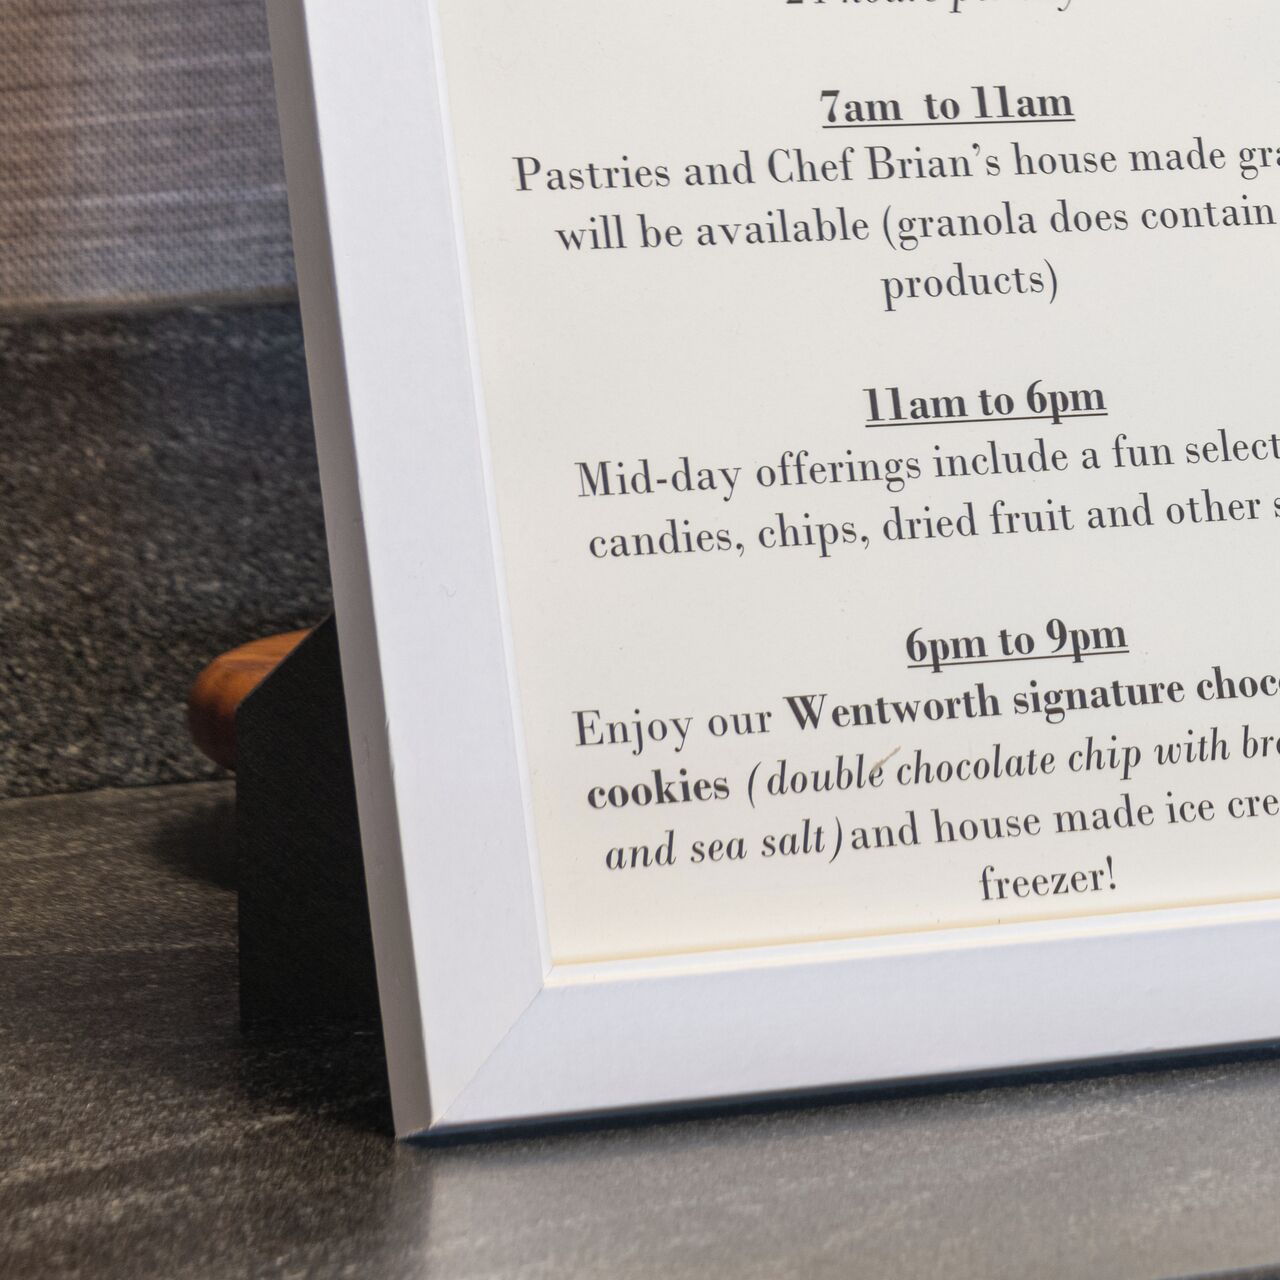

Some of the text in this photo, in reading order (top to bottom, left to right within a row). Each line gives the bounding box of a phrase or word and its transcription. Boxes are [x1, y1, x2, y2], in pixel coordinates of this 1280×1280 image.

[819, 85, 1075, 124] 7am to 11am
[511, 154, 671, 192] Pastries
[684, 149, 756, 187] and
[767, 146, 856, 184] Chef
[863, 142, 1001, 180] Brian’s
[1010, 141, 1118, 176] house
[1127, 136, 1226, 172] made
[554, 214, 628, 251] will
[636, 213, 683, 248] be
[696, 206, 870, 247] available
[882, 200, 1038, 252] (granola
[1049, 198, 1129, 233] does
[1140, 194, 1278, 230] contain
[879, 258, 1058, 313] products)
[862, 379, 1108, 425] 11am to 6pm
[573, 456, 742, 503] Mid-day
[756, 449, 922, 493] offerings
[932, 437, 1069, 478] include
[1081, 448, 1102, 470] a
[1111, 433, 1176, 468] fun
[588, 518, 745, 559] candies,
[758, 512, 870, 559] chips,
[882, 501, 980, 541] dried
[988, 498, 1075, 535] fruit
[1087, 491, 1155, 530] and
[1165, 488, 1261, 525] other
[905, 618, 1129, 673] 6pm to 9pm
[571, 708, 694, 756] Enjoy
[707, 711, 773, 737] our
[782, 682, 1003, 731] Wentworth
[1013, 679, 1185, 725] signature
[587, 767, 730, 810] cookies
[747, 753, 887, 809] (double
[896, 743, 1056, 786] chocolate
[1068, 734, 1142, 781] chip
[1153, 726, 1231, 766] with
[605, 829, 677, 871] and
[690, 837, 748, 864] sea
[930, 807, 1041, 844] house
[1052, 792, 1155, 834] made
[1165, 790, 1215, 824] ice
[978, 855, 1117, 901] freezer!
